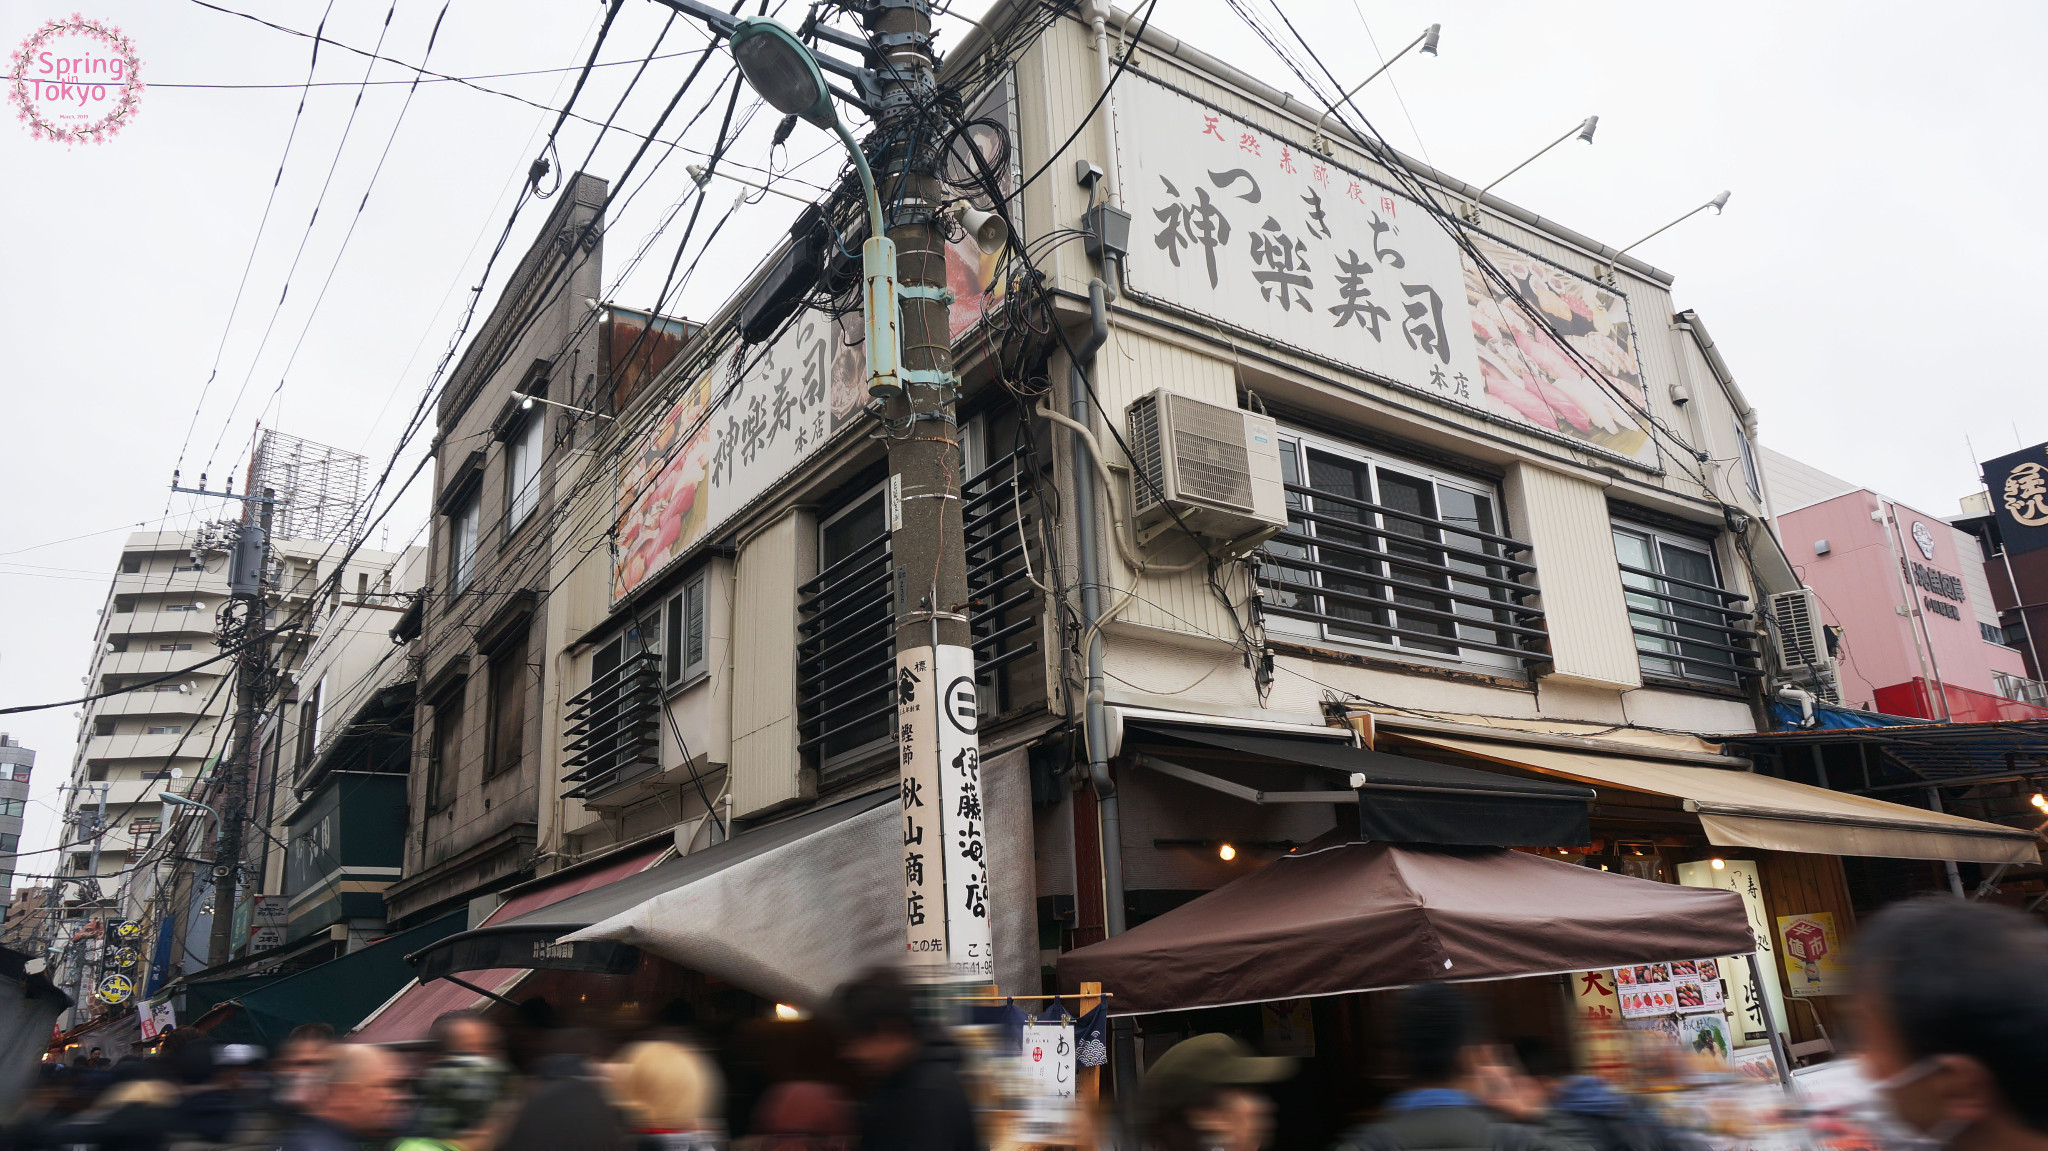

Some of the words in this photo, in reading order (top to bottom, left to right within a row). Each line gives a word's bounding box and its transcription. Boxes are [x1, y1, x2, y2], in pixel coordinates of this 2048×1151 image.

[1202, 113, 1397, 219] 天然赤酢使用
[1429, 364, 1471, 400] 本店
[793, 410, 825, 456] 本店
[900, 777, 926, 928] 秋山商店
[911, 938, 943, 953] この先
